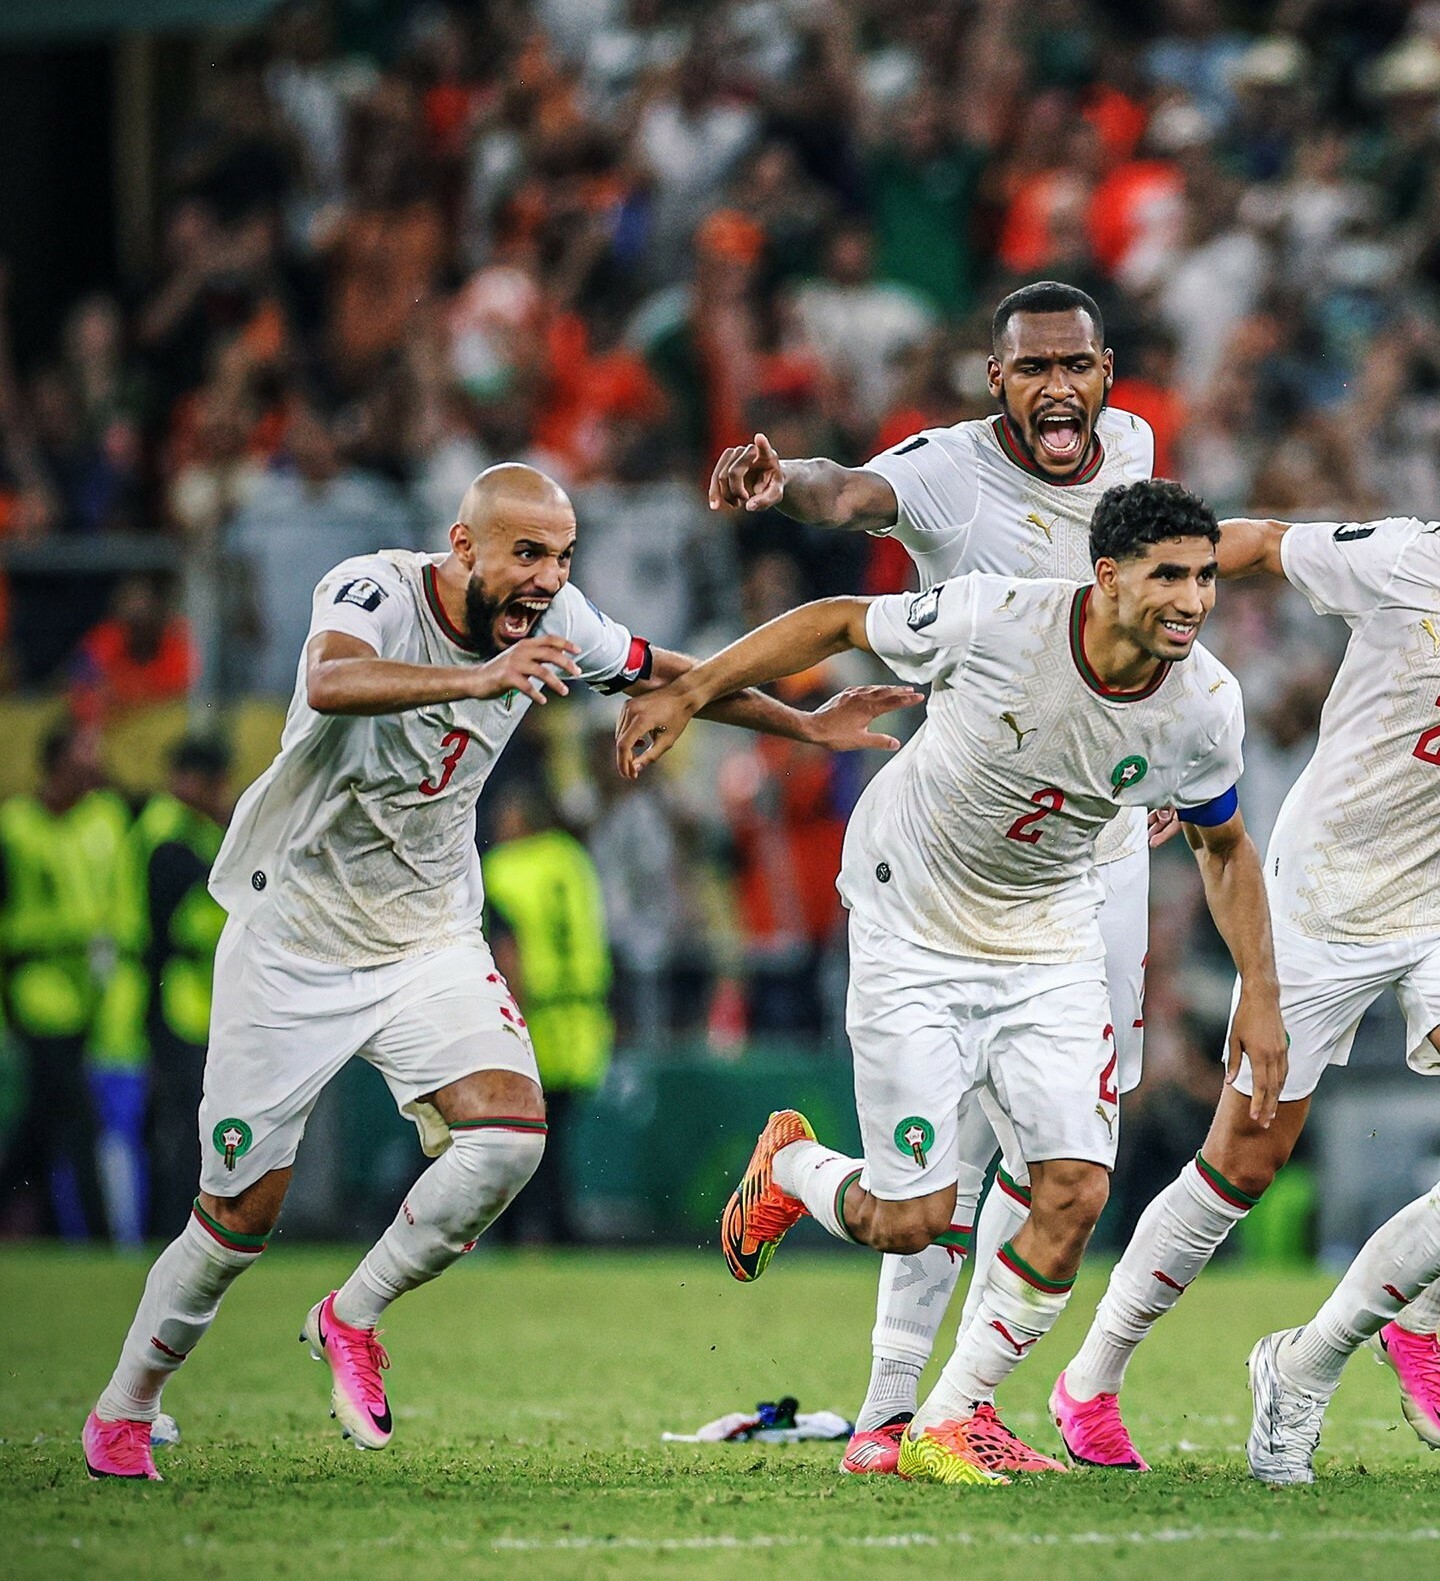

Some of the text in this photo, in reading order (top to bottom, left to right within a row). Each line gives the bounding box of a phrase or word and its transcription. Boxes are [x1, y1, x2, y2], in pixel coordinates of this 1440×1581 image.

[418, 728, 470, 796] 3
[1006, 787, 1065, 845] 2
[1098, 1023, 1118, 1106] 2
